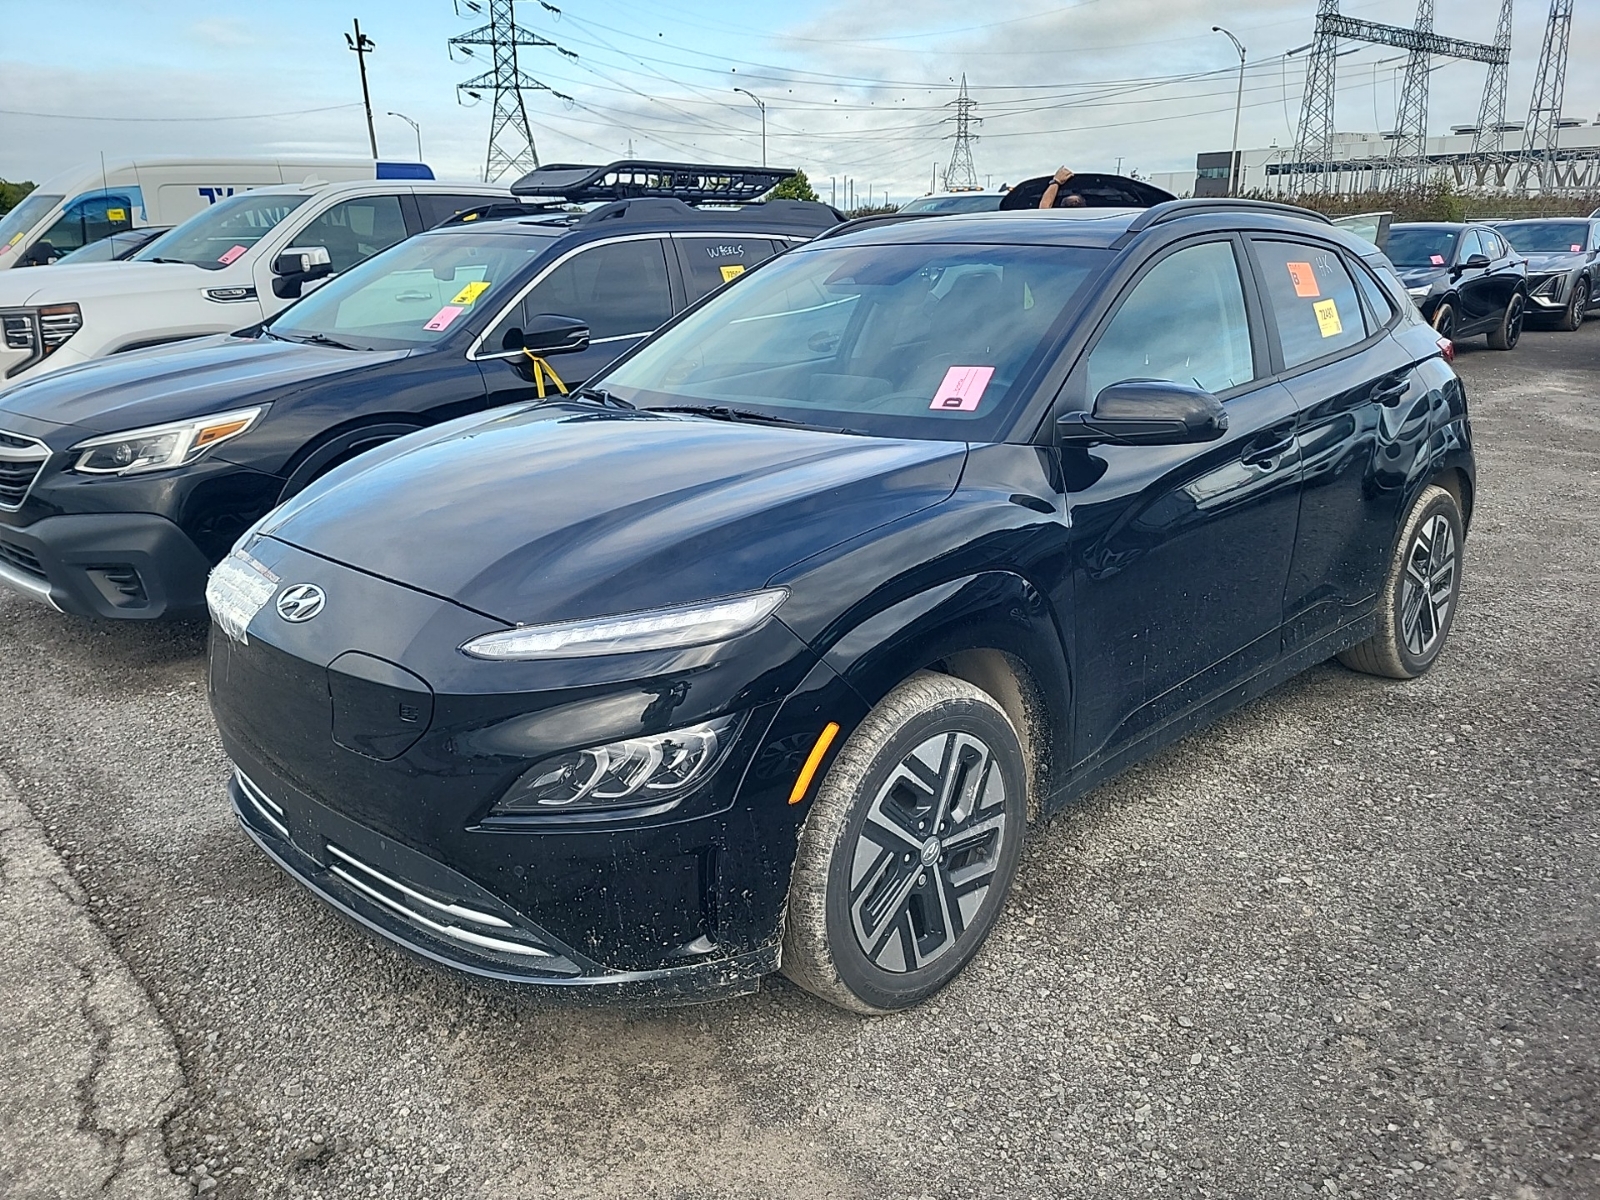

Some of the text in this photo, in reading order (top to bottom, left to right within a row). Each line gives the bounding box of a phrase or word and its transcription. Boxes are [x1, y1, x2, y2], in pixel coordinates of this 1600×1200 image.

[706, 244, 745, 258] WHEELS
[1291, 271, 1300, 286] B
[942, 397, 963, 407] D
